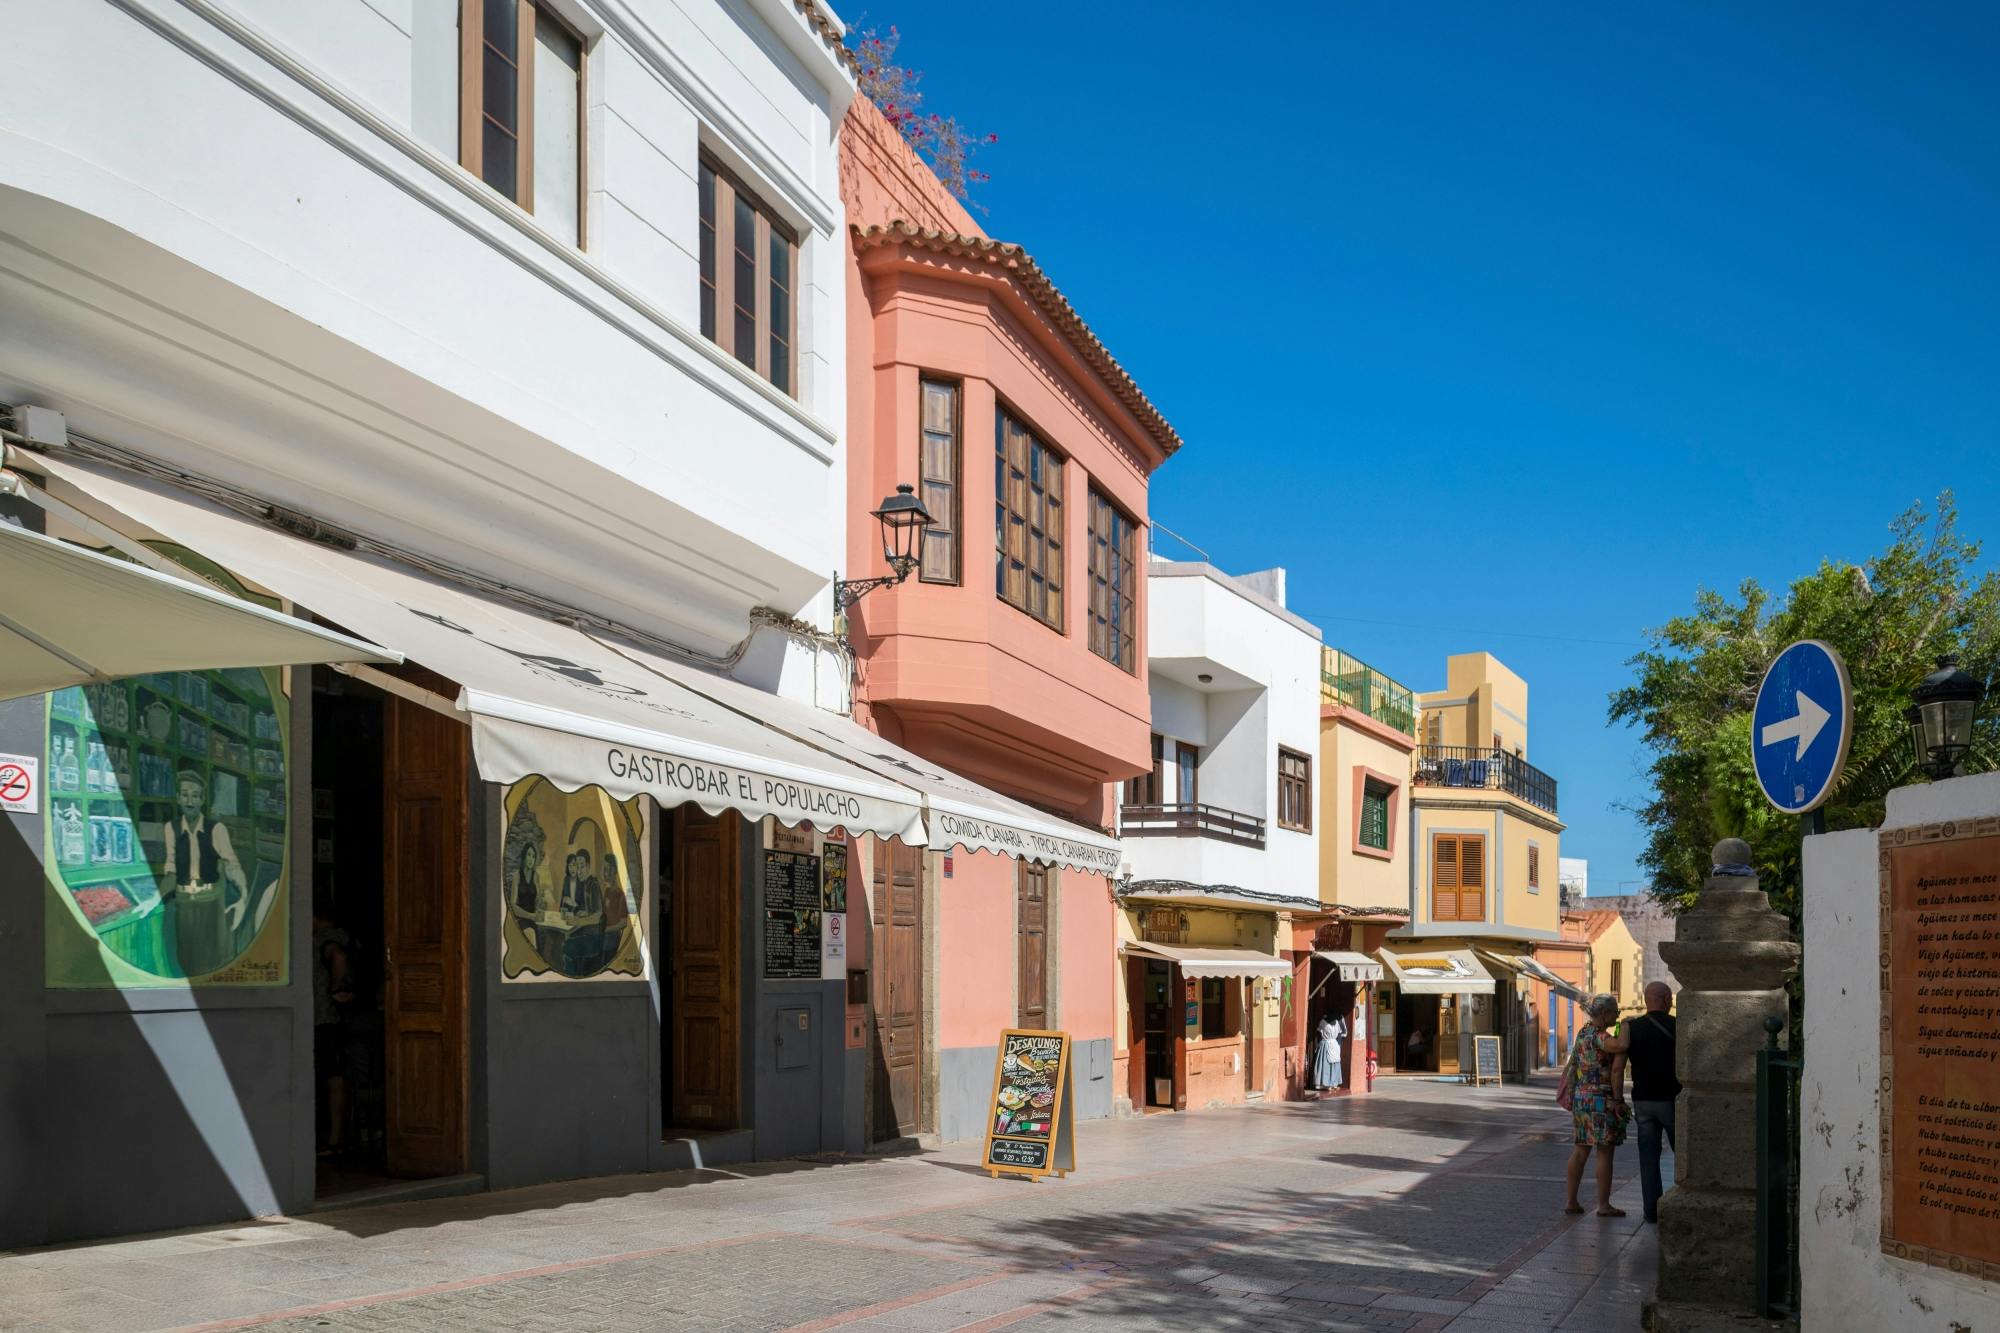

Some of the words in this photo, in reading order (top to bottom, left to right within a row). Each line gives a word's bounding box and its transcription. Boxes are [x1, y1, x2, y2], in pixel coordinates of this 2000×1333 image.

[608, 748, 729, 797] GASTROBAR
[739, 775, 757, 801] EL
[765, 780, 860, 819] POPULACHO
[941, 815, 984, 839] COMIDA
[985, 826, 1024, 848] CANARIA
[1031, 835, 1062, 856] TYPICAL
[1062, 843, 1097, 862] CANARIAN
[1917, 875, 1957, 890] Agüimes
[1960, 876, 1969, 885] se
[1972, 875, 1998, 884] mece
[1930, 894, 1946, 905] las
[1948, 893, 1996, 905] hamacas
[1917, 912, 1958, 927] Agüimes
[1960, 914, 1970, 922] se
[1972, 912, 1998, 922] mece
[1918, 934, 1934, 944] que
[1982, 929, 1993, 940] lo
[1918, 949, 1940, 964] Viejo
[1918, 968, 1940, 981] viejo
[1942, 968, 1955, 978] de
[1918, 986, 1929, 996] de
[1931, 986, 1954, 997] soles
[1956, 989, 1963, 1000] y
[1918, 1004, 1929, 1014] de
[1931, 1004, 1985, 1019] nostalgias
[1987, 1008, 1994, 1020] y
[1919, 1025, 1944, 1040] Sigue
[1007, 1037, 1062, 1054] DESAYUNOS
[1918, 1044, 1944, 1058] sigue
[1945, 1045, 1988, 1058] soñando
[1991, 1050, 1998, 1062] y
[1919, 1095, 1928, 1105] El
[1946, 1098, 1958, 1110] de
[1960, 1099, 1972, 1111] tu
[1918, 1114, 1933, 1123] era
[1934, 1114, 1943, 1124] el
[1944, 1116, 1984, 1130] solsticio
[1985, 1119, 1997, 1132] de
[1918, 1128, 1940, 1141] Hubo
[1941, 1131, 1985, 1148] tambores
[1986, 1140, 1993, 1150] y
[1918, 1148, 1924, 1157] y
[1925, 1148, 1948, 1159] hubo
[1948, 1152, 1991, 1166] cantares
[1993, 1159, 2000, 1170] y
[1919, 1161, 1938, 1174] Todo
[1939, 1166, 1948, 1176] el
[1949, 1168, 1981, 1182] pueblo
[1982, 1175, 1999, 1185] era
[1919, 1181, 1926, 1190] y
[1926, 1180, 1936, 1191] la
[1936, 1182, 1964, 1196] plaza
[1966, 1187, 1987, 1200] todo
[1988, 1191, 1998, 1202] el
[1919, 1195, 1929, 1206] El
[1930, 1198, 1942, 1208] sol
[1944, 1202, 1954, 1211] se
[1978, 1207, 1990, 1218] de
